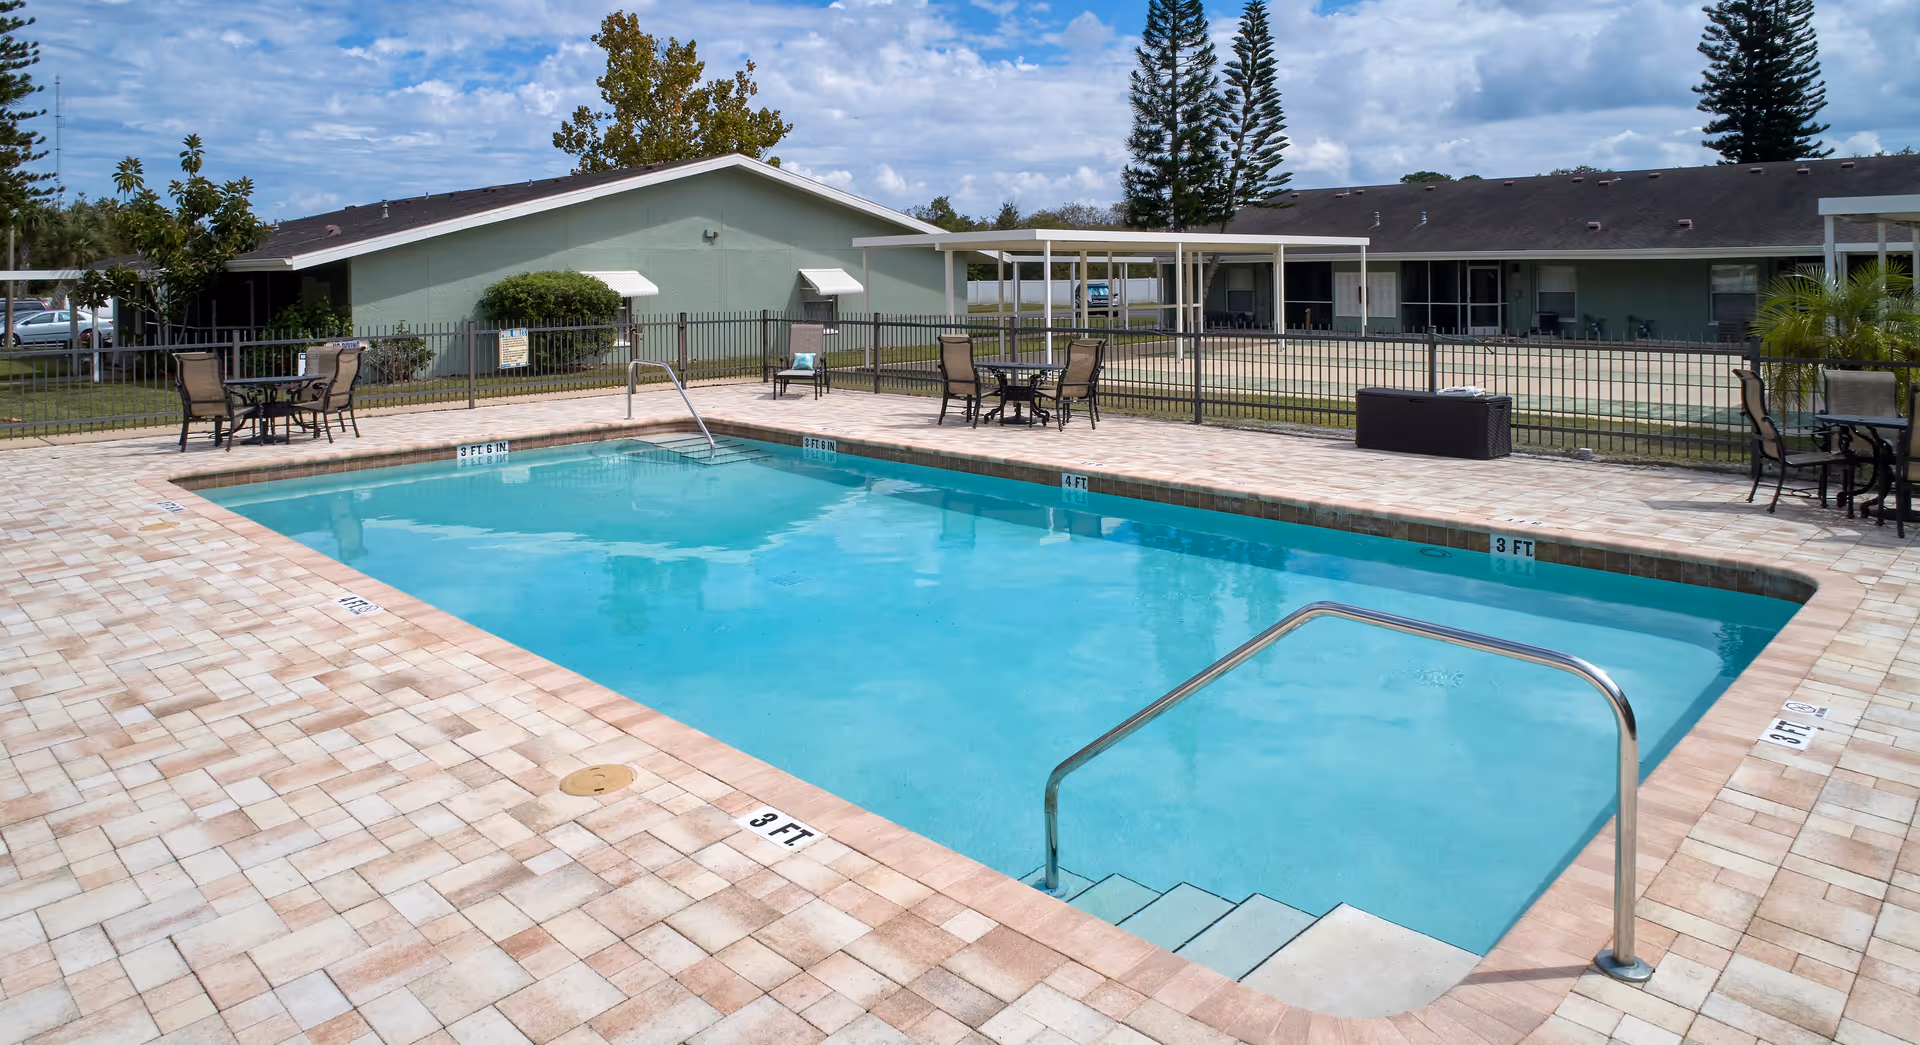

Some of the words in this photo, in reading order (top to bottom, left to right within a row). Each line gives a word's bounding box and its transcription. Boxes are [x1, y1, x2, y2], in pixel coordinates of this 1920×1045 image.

[460, 446, 467, 457] 3
[486, 443, 493, 454] 6
[496, 441, 508, 453] IN.
[805, 437, 810, 448] 3
[821, 440, 826, 450] 6
[1065, 475, 1072, 487] 4
[1075, 476, 1087, 490] FT.
[1496, 537, 1506, 553] 3
[1513, 539, 1533, 557] FT.
[1769, 733, 1802, 745] 3
[749, 812, 779, 828] 3
[767, 822, 816, 847] FT.
